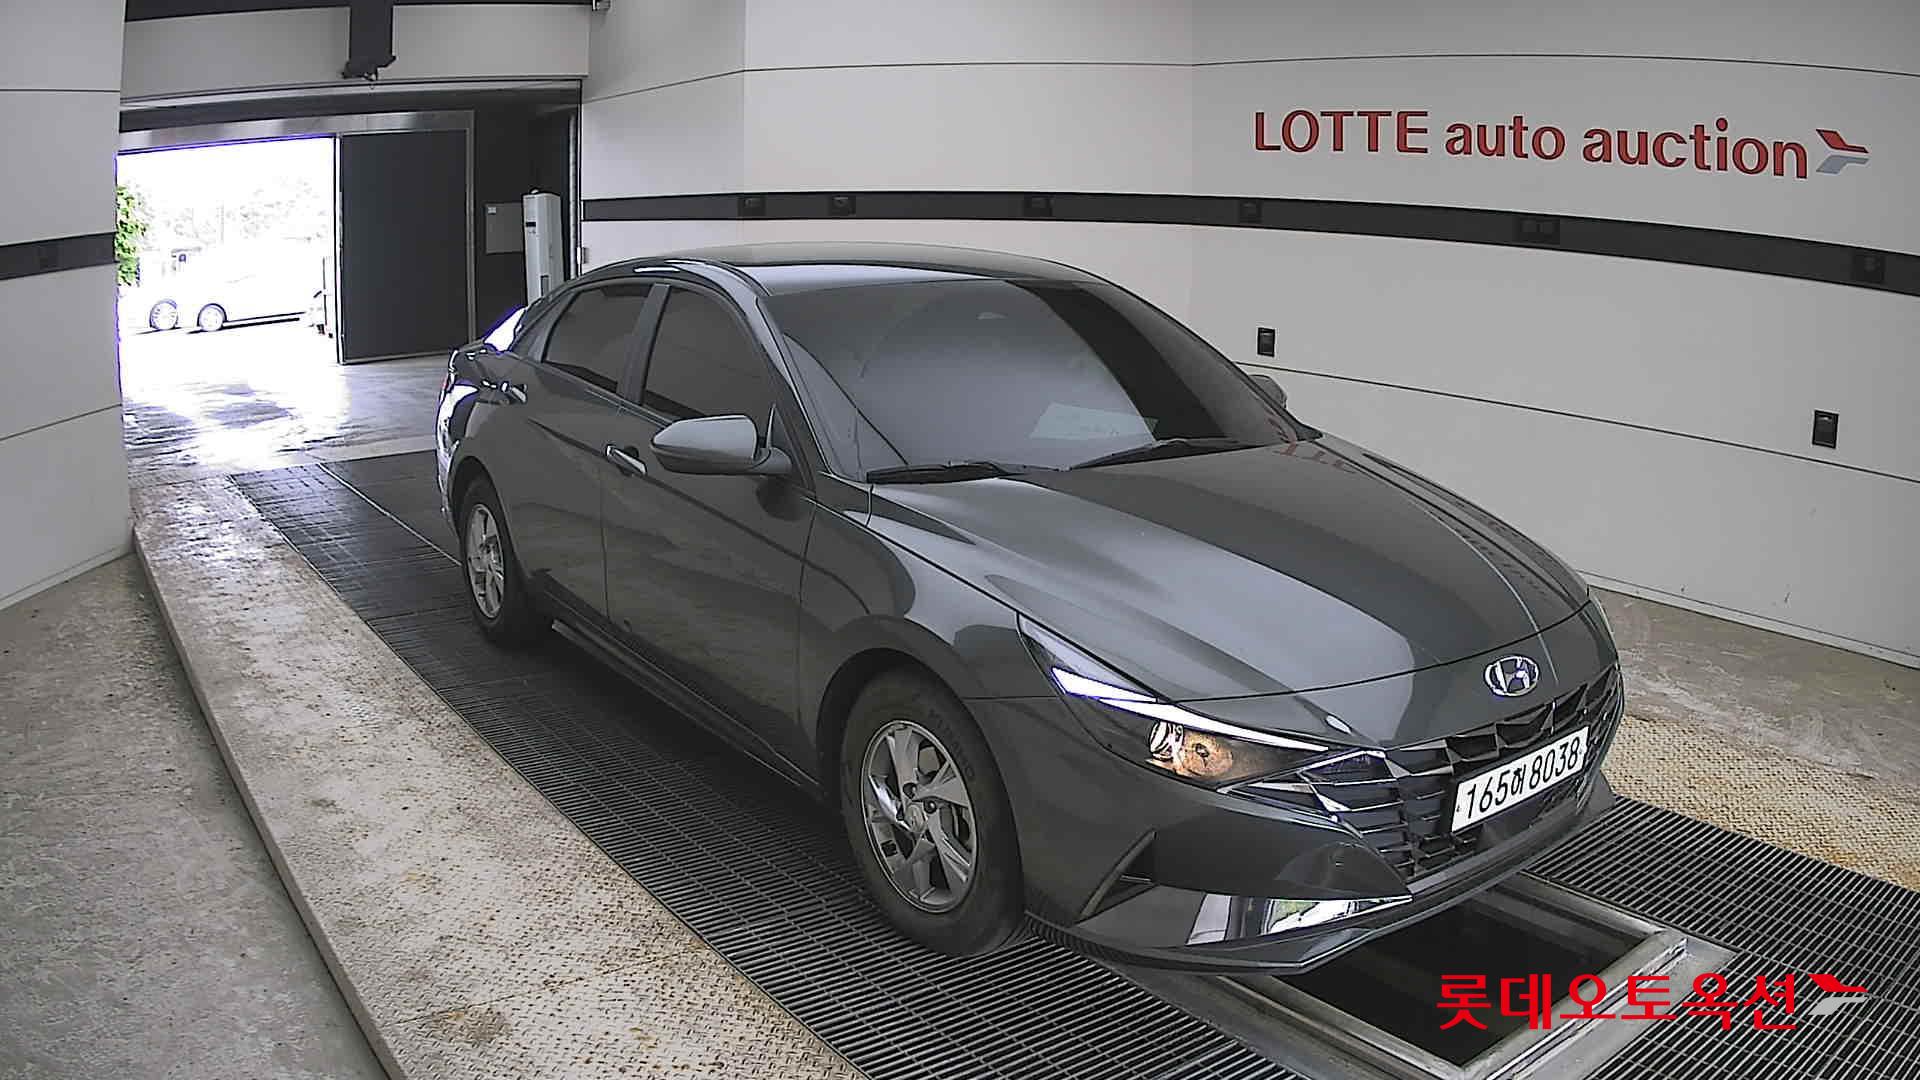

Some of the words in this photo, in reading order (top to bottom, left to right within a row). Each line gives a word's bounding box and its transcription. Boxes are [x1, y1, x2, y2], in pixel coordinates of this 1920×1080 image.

[1254, 110, 1430, 155] LOTTE
[1445, 115, 1567, 160] auto
[1583, 117, 1809, 178] auction
